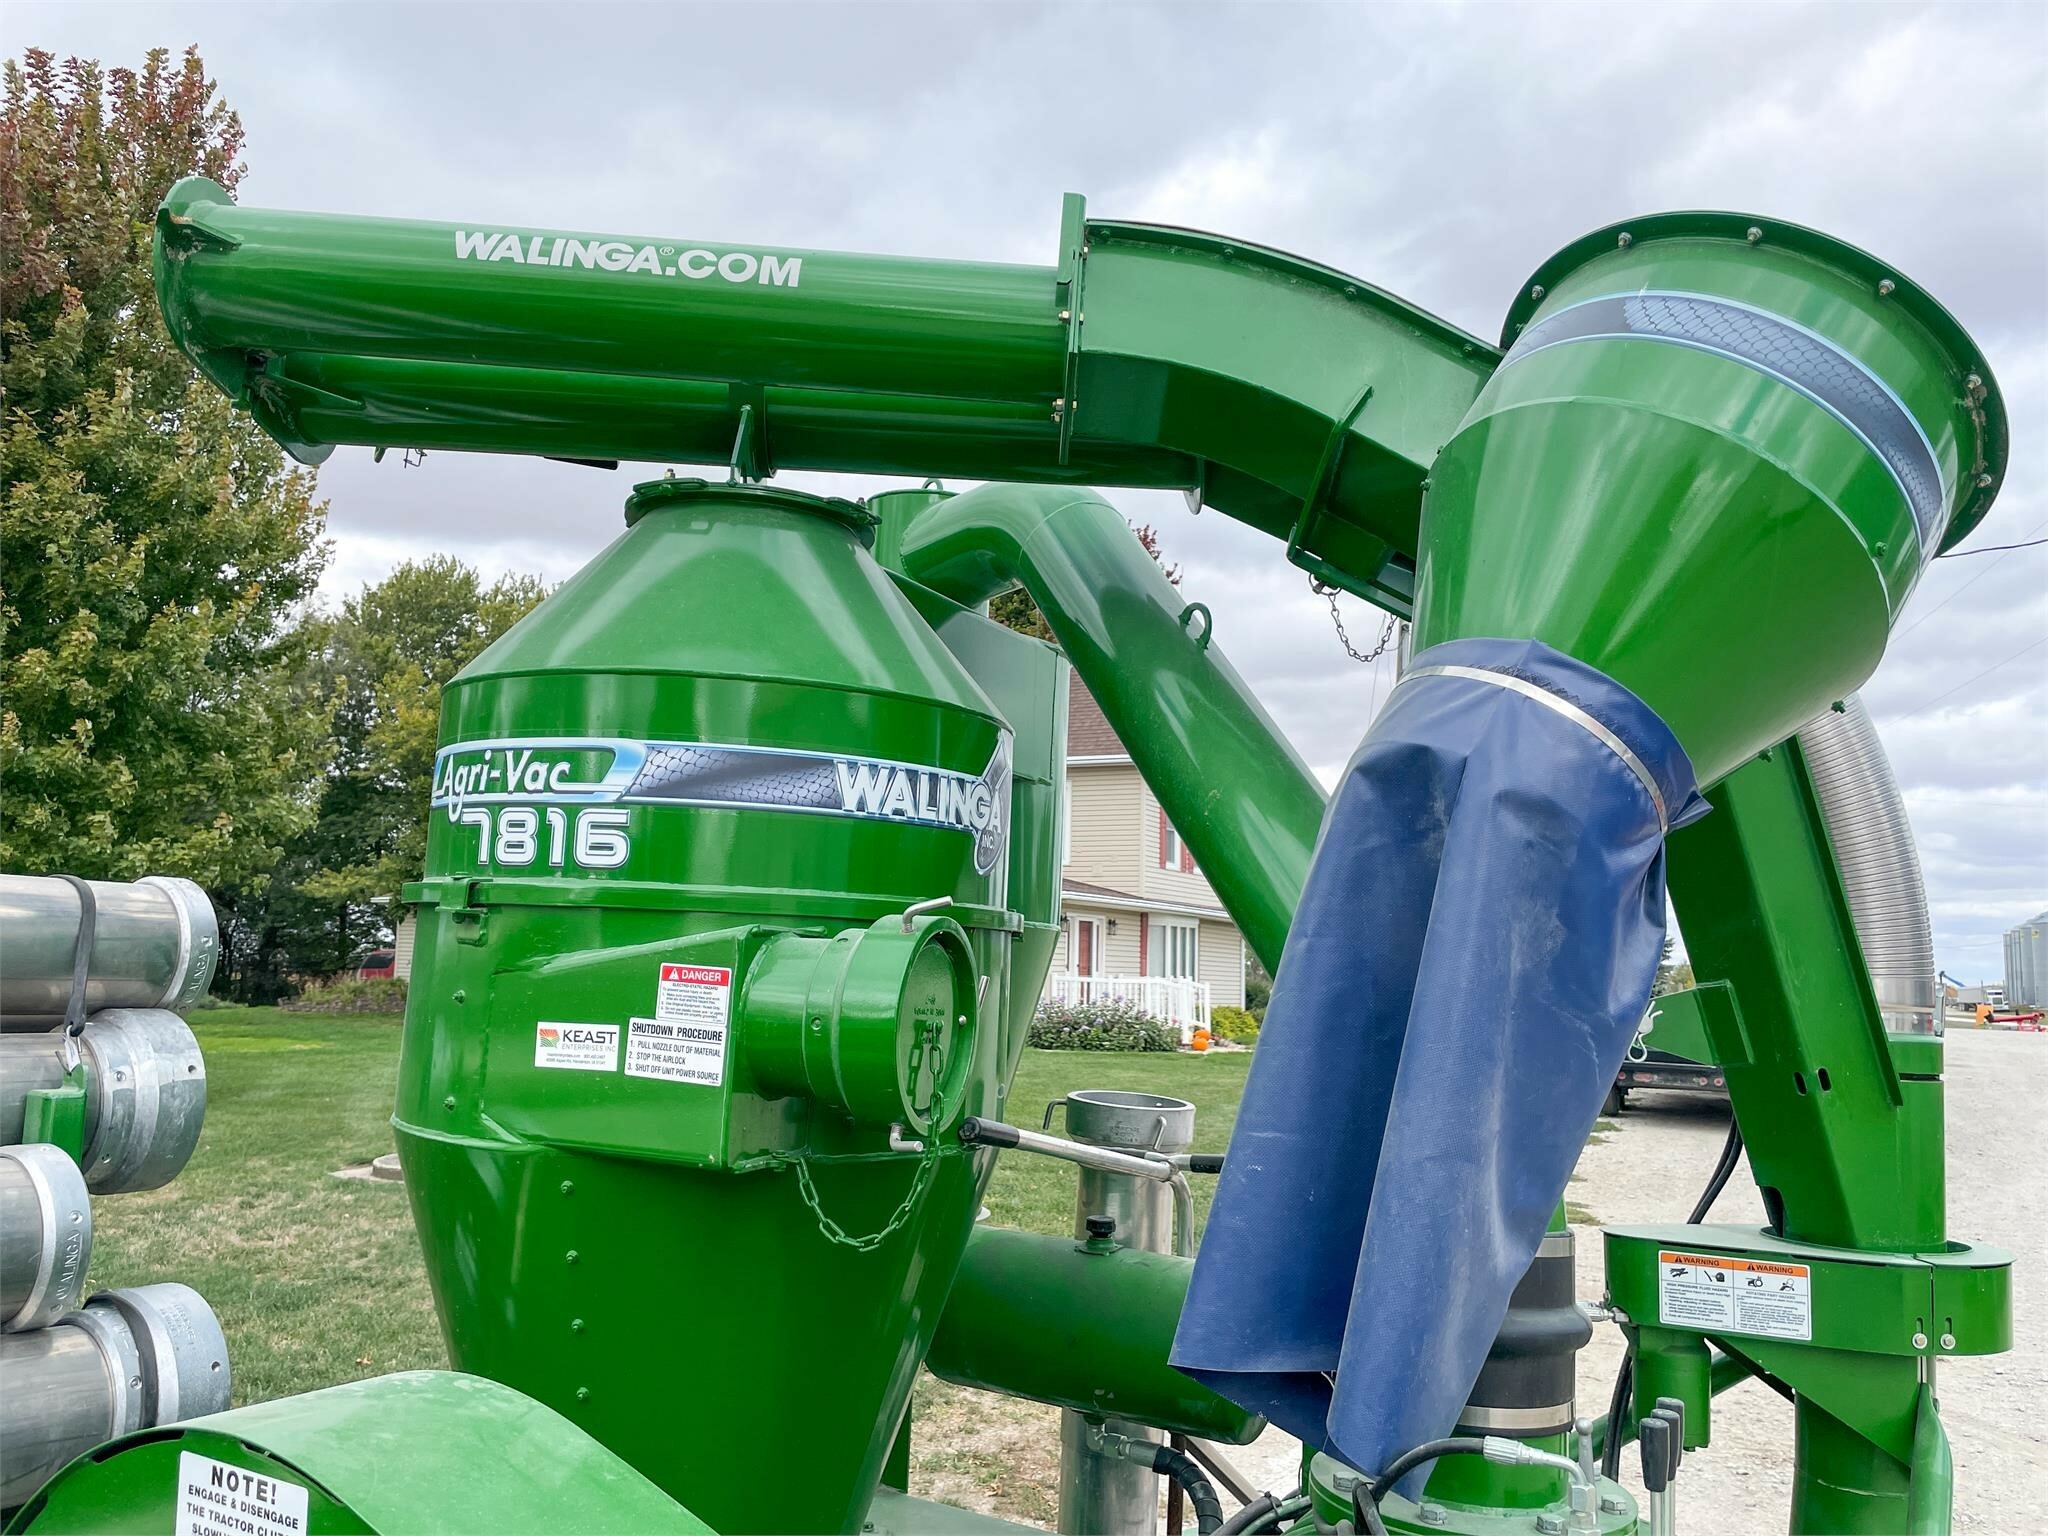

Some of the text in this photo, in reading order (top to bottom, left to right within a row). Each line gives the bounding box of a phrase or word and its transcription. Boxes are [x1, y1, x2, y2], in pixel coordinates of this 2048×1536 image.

[436, 749, 572, 823] Agri-Vac
[833, 760, 1002, 833] WALINGA
[460, 806, 631, 868] 7816
[681, 968, 722, 983] DANGER
[562, 1029, 617, 1045] KEAST
[631, 1022, 723, 1042] SHUTDOWN PROCEDURE
[562, 1044, 616, 1053] ENTERPRISES INC
[628, 1051, 686, 1065] 2. STOP THE AIRLOCK
[637, 1040, 651, 1050] PULL
[652, 1042, 672, 1052] NOZZLE
[673, 1045, 685, 1053] OUT
[686, 1046, 693, 1054] OF
[694, 1047, 721, 1058] MATERIAL
[627, 1062, 719, 1081] 3. SHUT OFF UNIT POWER SOURCE
[1683, 1256, 1720, 1267] WARNING
[1756, 1264, 1794, 1274] WARNING
[211, 1464, 277, 1505] NOTE!
[188, 1484, 299, 1530] ENGAGE & DISENGAGE
[187, 1502, 205, 1518] THE
[208, 1509, 254, 1534] TRACTOR
